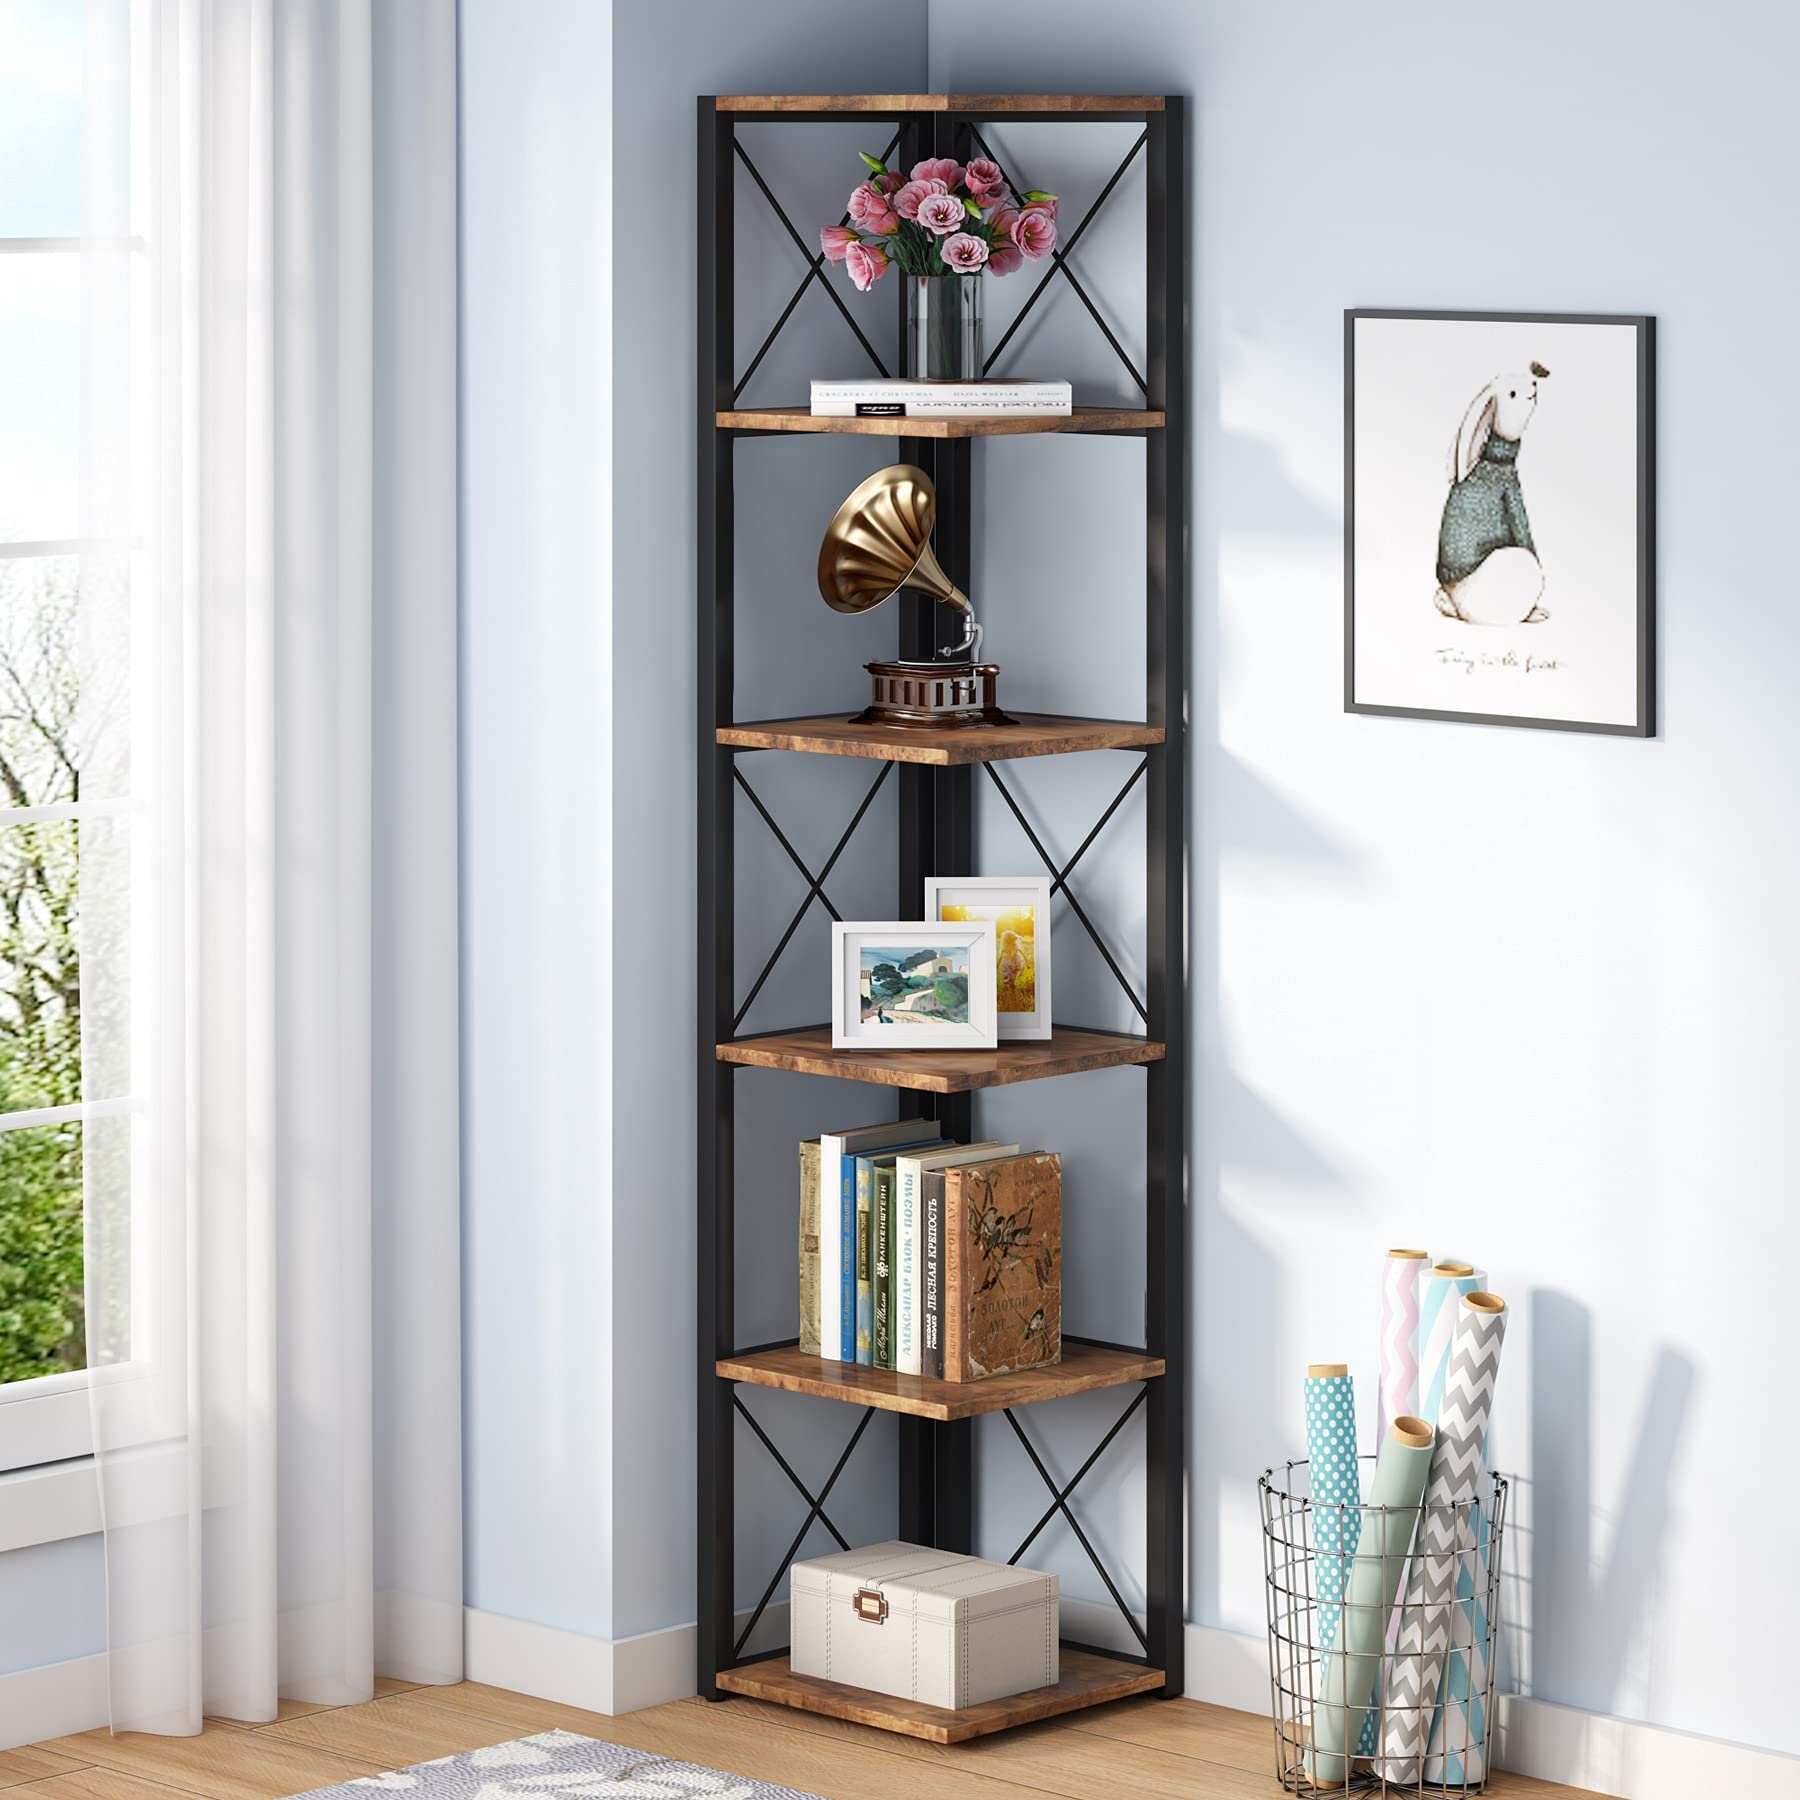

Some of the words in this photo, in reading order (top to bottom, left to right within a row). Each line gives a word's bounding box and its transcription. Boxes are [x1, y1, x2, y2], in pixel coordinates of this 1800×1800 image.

[903, 1174, 913, 1228] ПОЭМЫ
[927, 1198, 937, 1258] КРЕПОСТЬ
[903, 1238, 913, 1273] БЛОК
[927, 1261, 937, 1311] ЛЕСНАЯ
[902, 1278, 912, 1356] АЛЕКСАНДР
